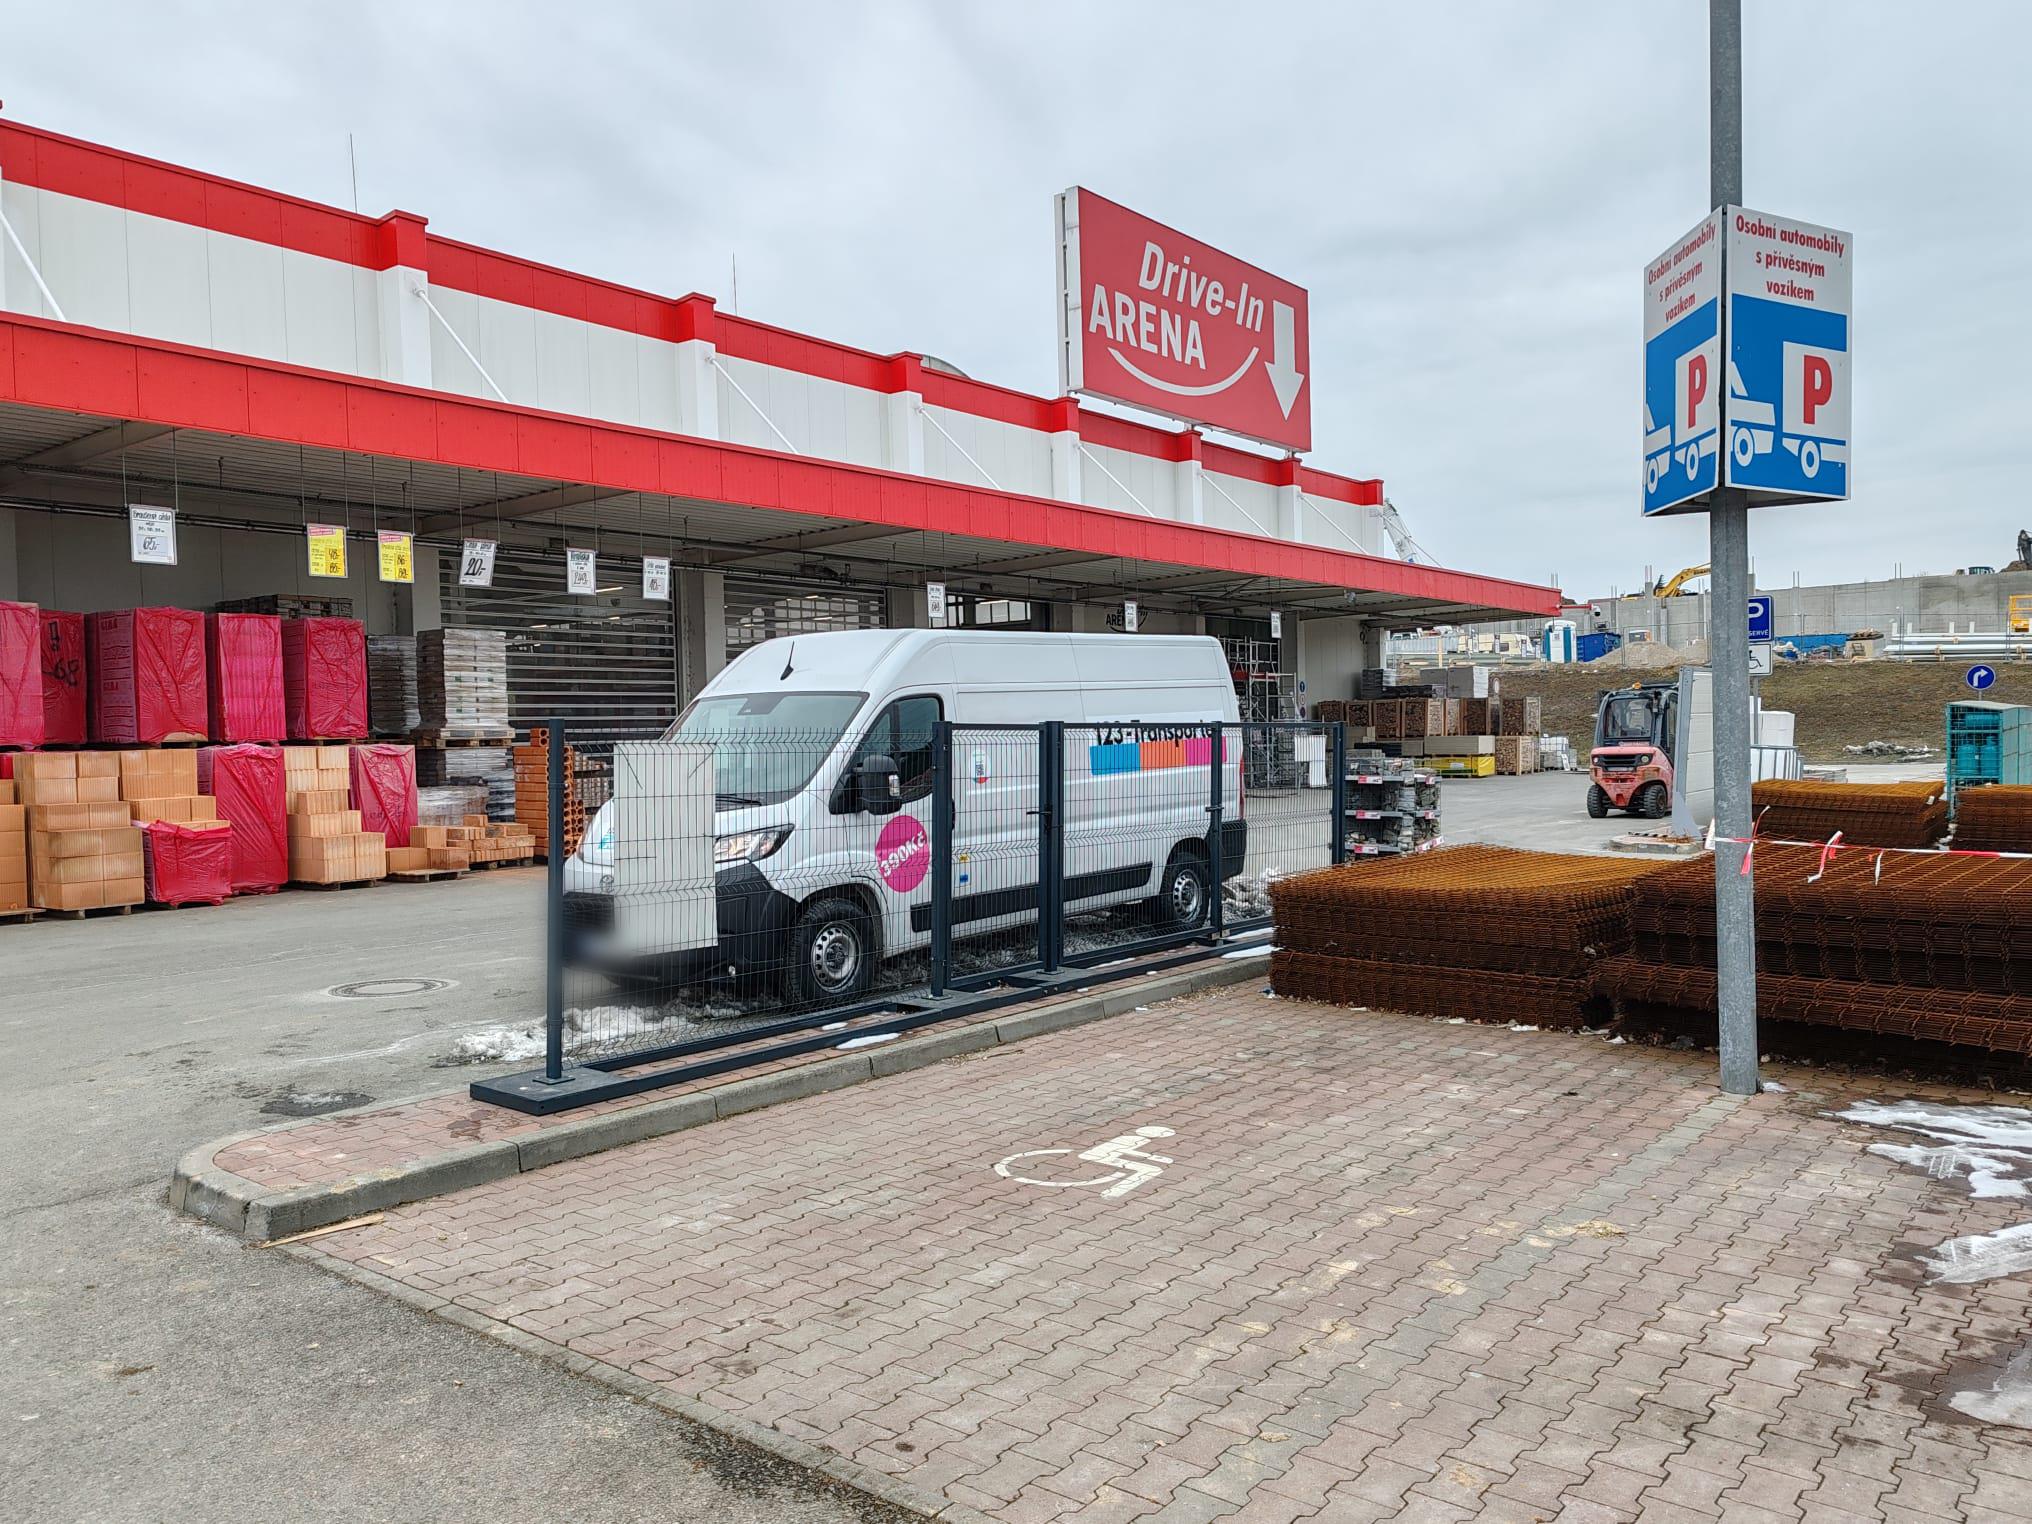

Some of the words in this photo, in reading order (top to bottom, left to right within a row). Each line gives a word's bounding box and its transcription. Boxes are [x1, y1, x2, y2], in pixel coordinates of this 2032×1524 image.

[1648, 253, 1672, 285] Osobní
[1673, 221, 1716, 266] automobily
[1736, 215, 1777, 240] Osobní
[1780, 229, 1845, 258] automobily
[1138, 240, 1264, 332] Drive-In
[1659, 290, 1664, 302] s
[1665, 261, 1703, 301] přívěsným
[1755, 251, 1762, 264] s
[1765, 249, 1825, 278] přívěsným
[1665, 293, 1696, 323] vozíkem
[1766, 280, 1814, 301] vozíkem
[1088, 283, 1206, 369] ARENA
[1688, 354, 1707, 429] P
[1803, 354, 1833, 425] P
